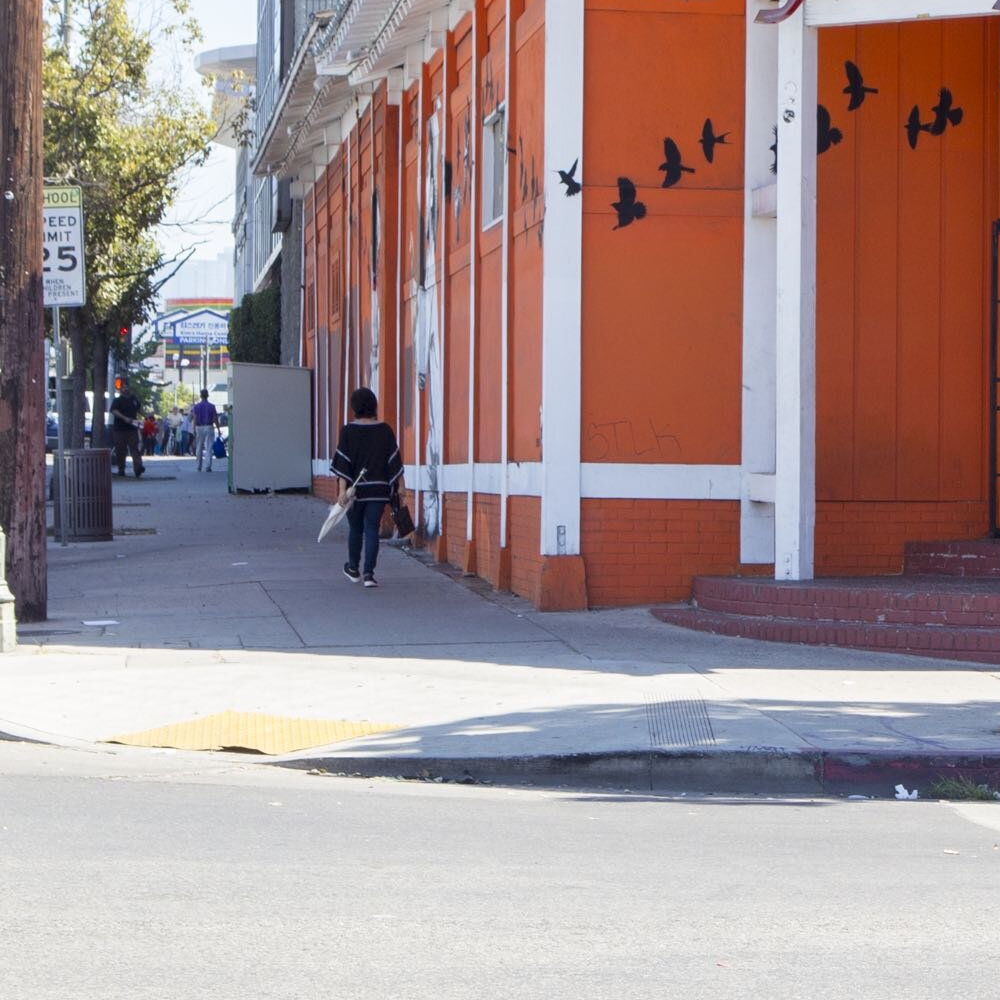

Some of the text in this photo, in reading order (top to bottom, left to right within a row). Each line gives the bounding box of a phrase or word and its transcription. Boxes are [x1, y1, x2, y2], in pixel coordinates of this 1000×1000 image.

[43, 190, 77, 204] HOOL
[43, 215, 77, 227] EED
[43, 231, 71, 242] IMIT
